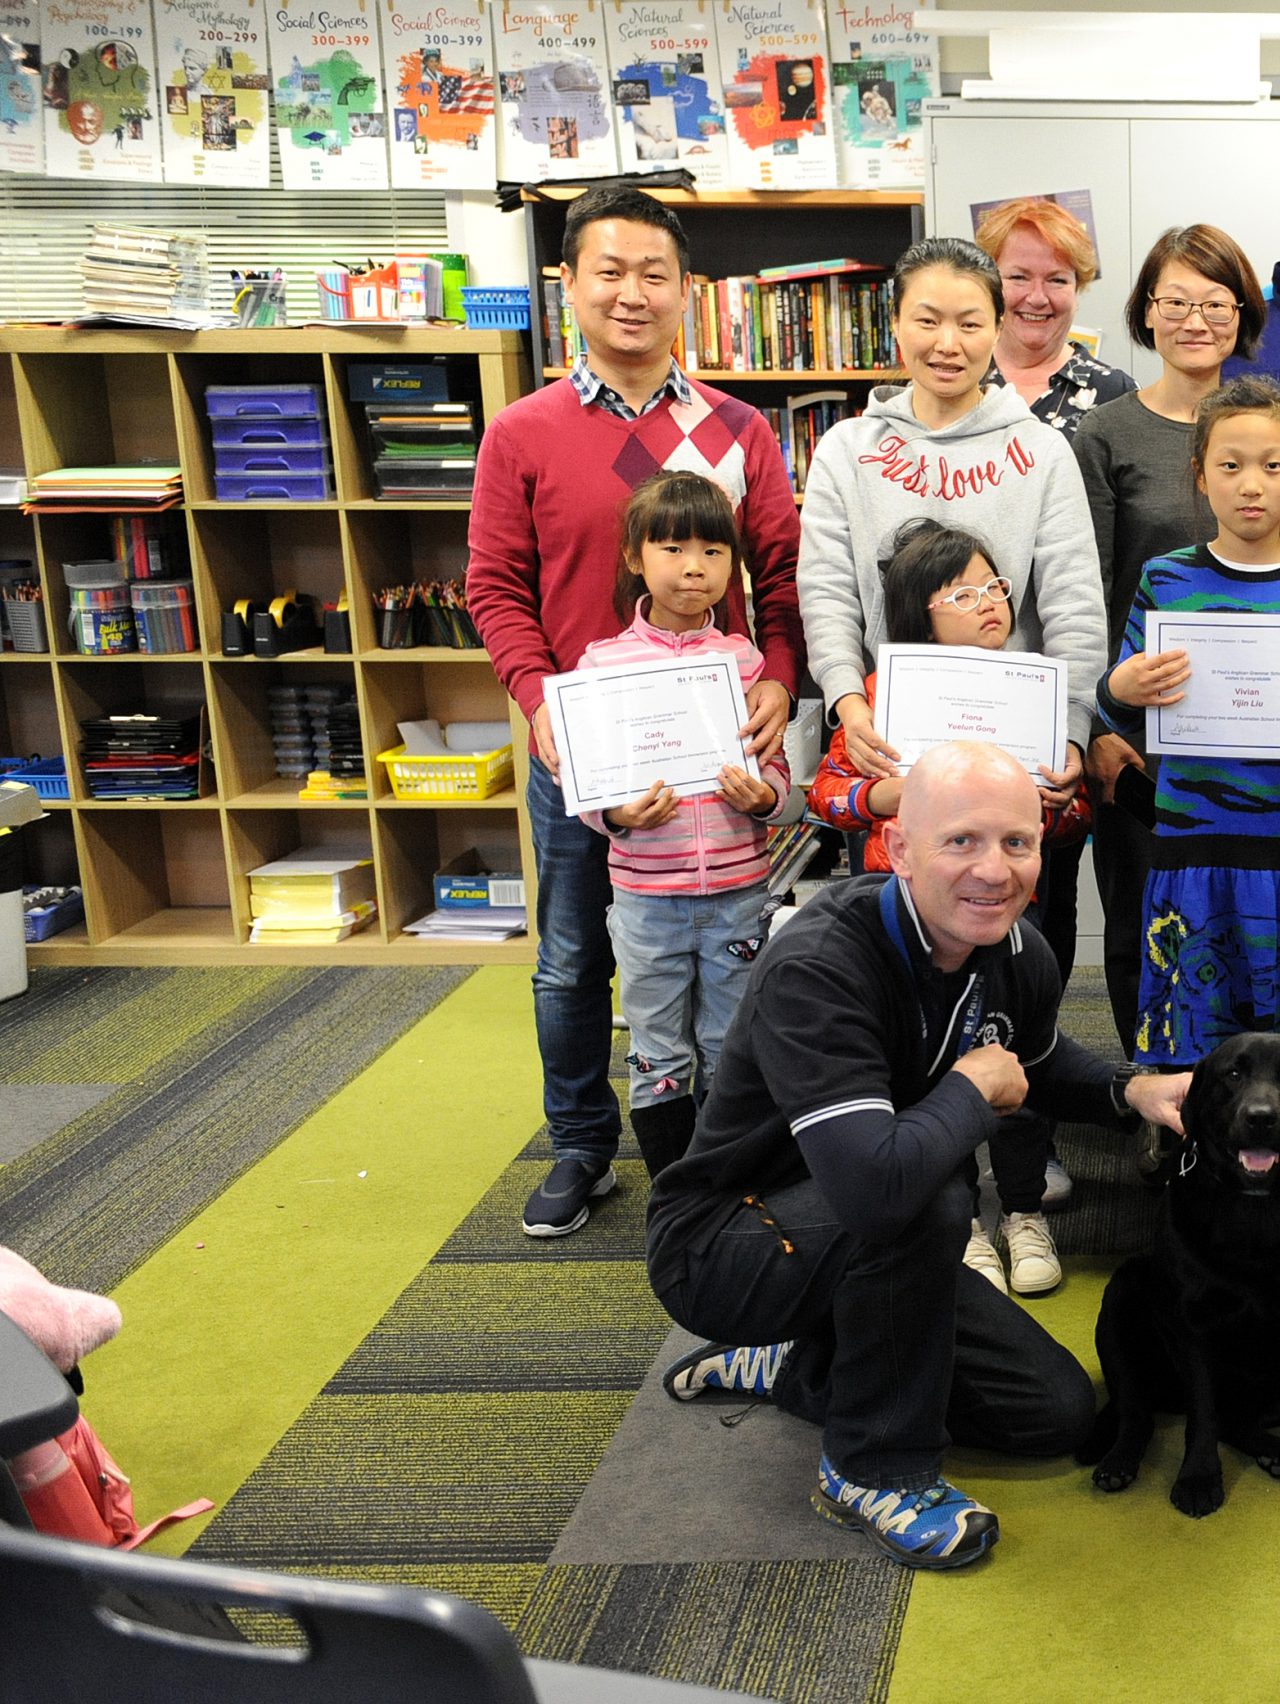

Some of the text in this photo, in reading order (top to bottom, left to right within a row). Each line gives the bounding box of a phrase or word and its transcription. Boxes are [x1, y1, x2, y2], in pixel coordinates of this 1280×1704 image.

[629, 7, 684, 25] Natural
[728, 2, 783, 23] Natural
[276, 10, 368, 33] Social Sciences
[391, 7, 481, 37] Social Sciences
[502, 10, 579, 37] Language
[835, 6, 914, 33] Technolog
[85, 24, 143, 38] 100-199
[200, 30, 258, 43] 200-299
[618, 23, 669, 42] Sciences
[744, 22, 796, 41] Sciences
[311, 35, 370, 46] 300-399
[424, 34, 483, 46] 300-399
[538, 37, 596, 48] 400-499
[650, 38, 709, 50] 500-599
[759, 33, 818, 46] 500-599
[858, 436, 930, 498] Just
[932, 456, 1005, 500] love
[1235, 688, 1260, 696] Vivian
[961, 713, 983, 721] Fiona
[644, 731, 665, 739] Cady
[661, 739, 682, 748] Yang
[964, 1021, 974, 1034] St
